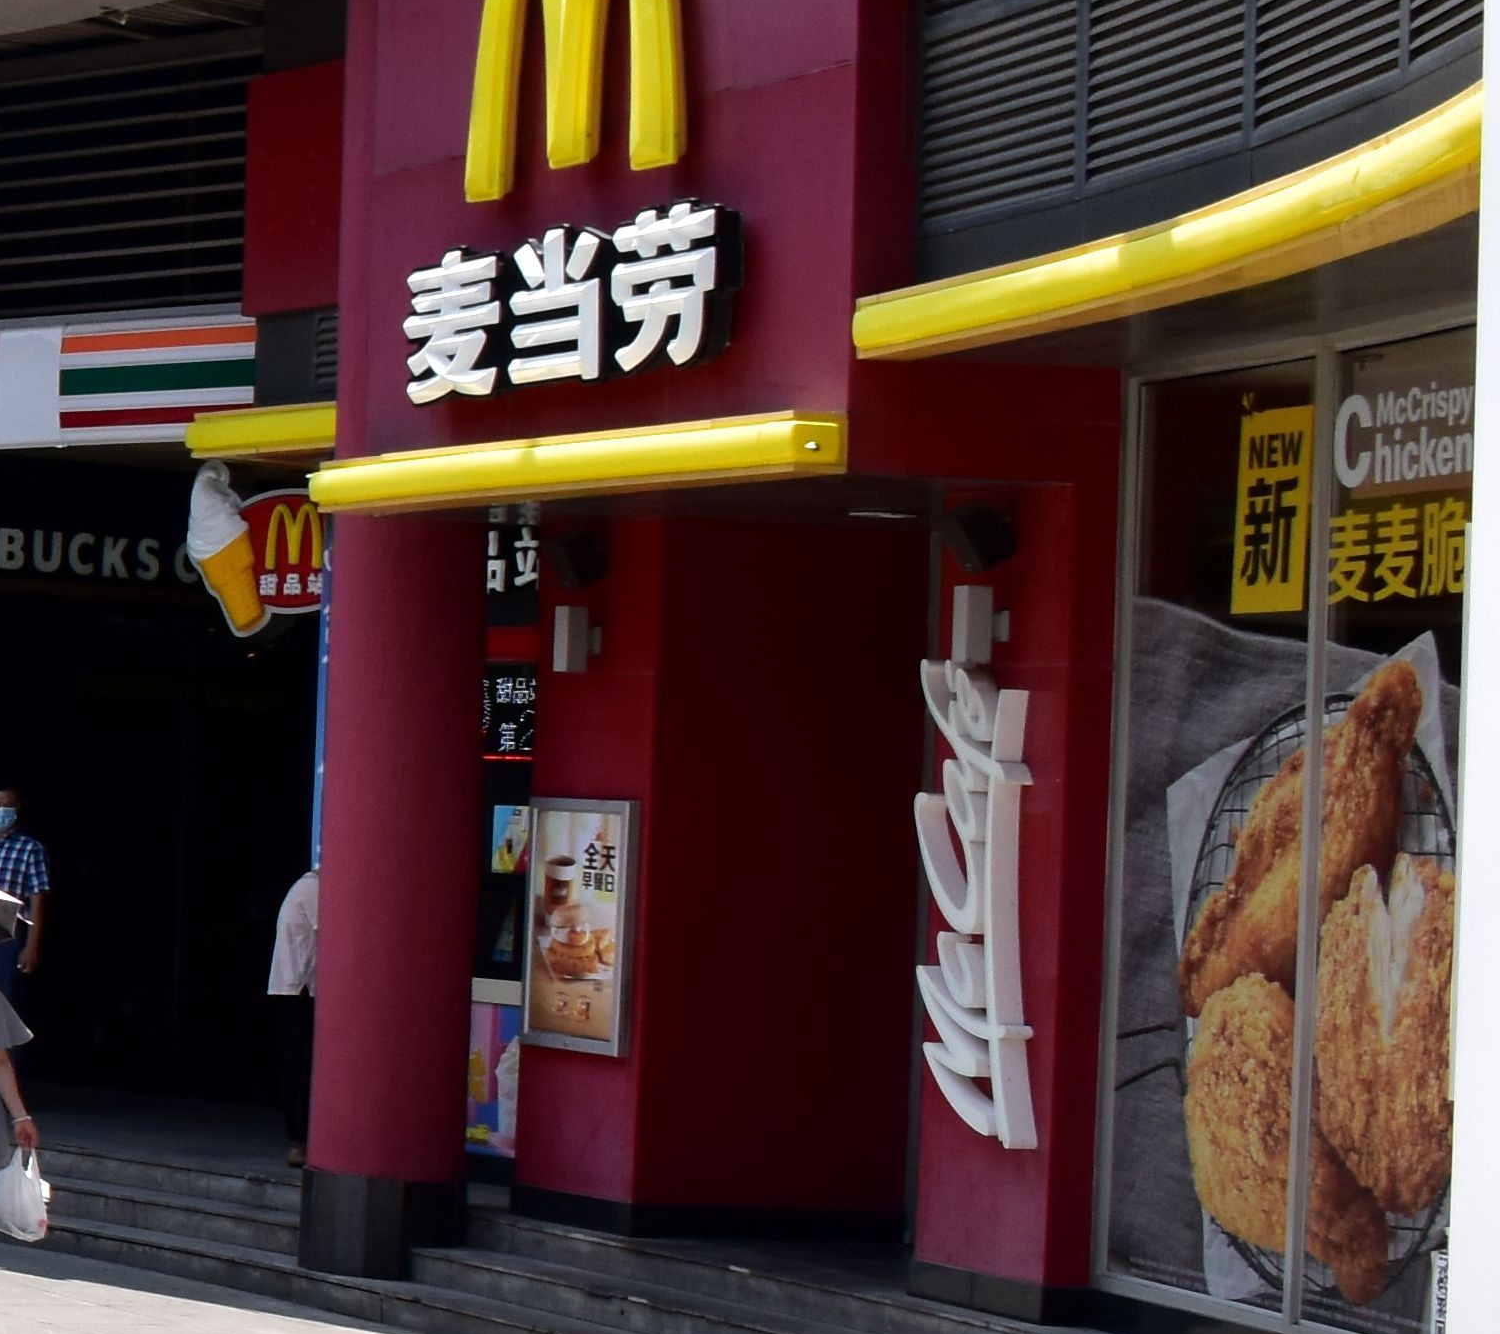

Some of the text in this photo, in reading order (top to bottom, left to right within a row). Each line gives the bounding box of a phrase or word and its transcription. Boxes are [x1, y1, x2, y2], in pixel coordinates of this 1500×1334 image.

[400, 197, 722, 407] 麦当劳
[1375, 381, 1475, 428] McCrispy
[1248, 430, 1303, 471] NEW
[1240, 475, 1298, 587] 新
[1328, 496, 1467, 605] 麦麦脆
[258, 571, 324, 597] 甜品站
[583, 842, 617, 873] 全天
